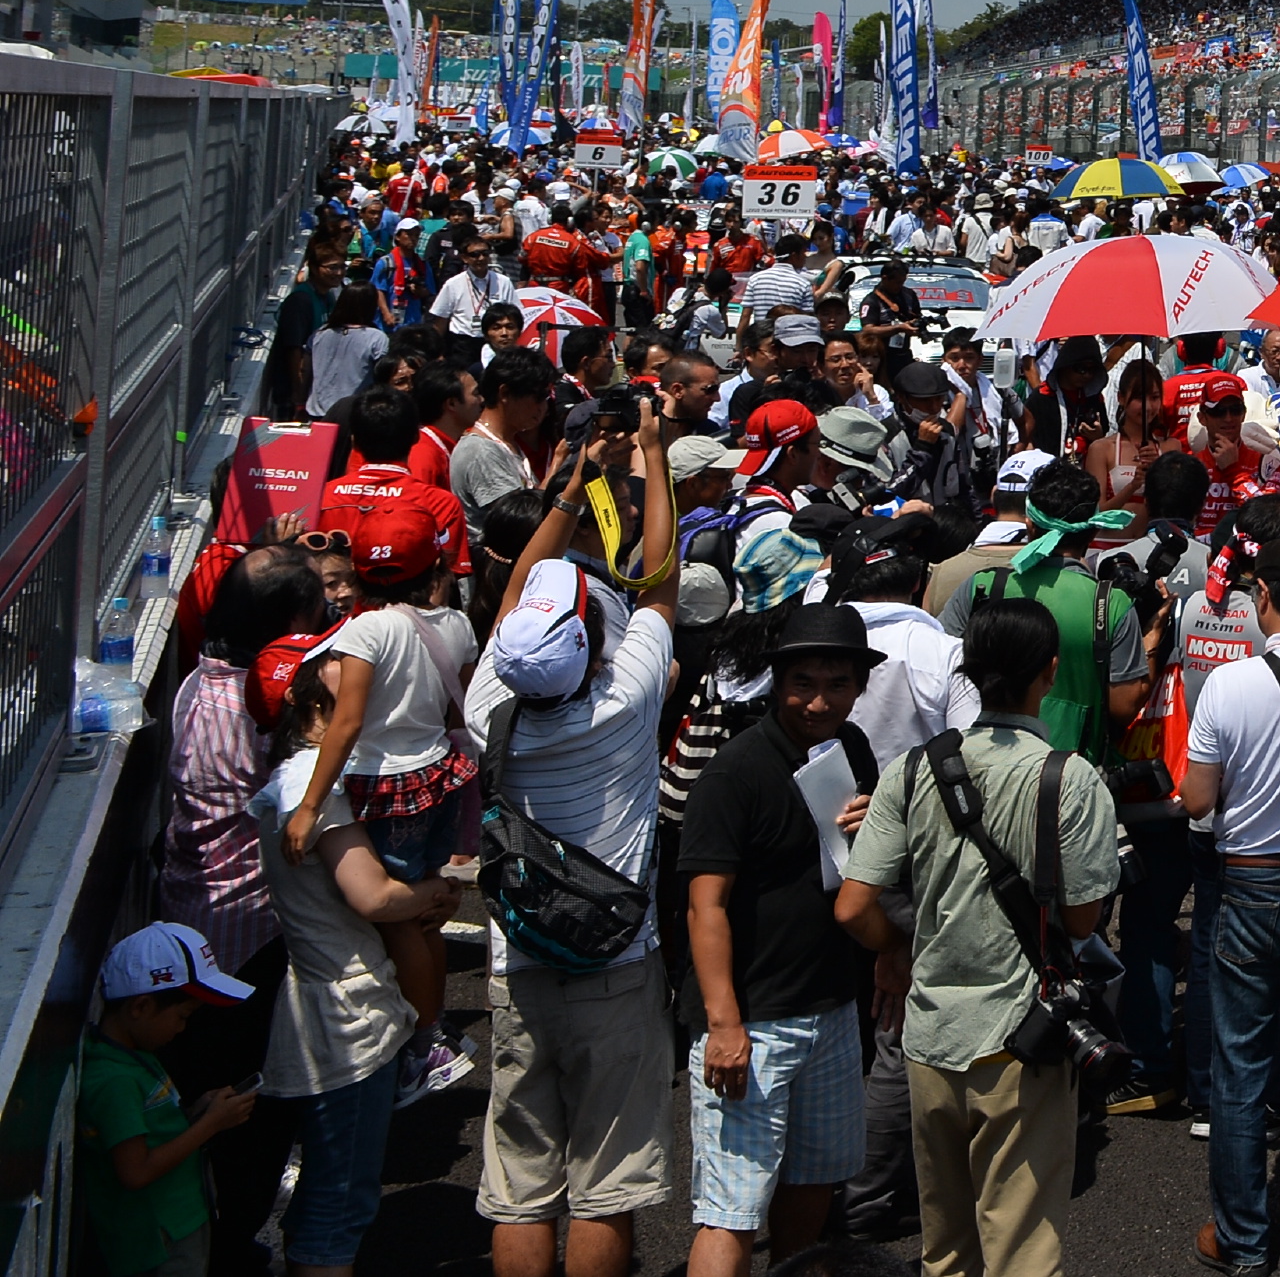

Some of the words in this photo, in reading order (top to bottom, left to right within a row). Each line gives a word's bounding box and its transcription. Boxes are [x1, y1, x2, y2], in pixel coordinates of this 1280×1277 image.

[591, 146, 605, 160] 6
[1028, 150, 1050, 161] 100
[757, 182, 801, 206] 36
[986, 255, 1078, 329] AUTECH
[1172, 249, 1214, 325] AUTECH
[861, 305, 869, 317] 9
[1179, 383, 1206, 391] NISSA
[1011, 460, 1026, 469] 23
[249, 467, 309, 480] NISSAN
[334, 484, 403, 497] NISSAN
[369, 545, 392, 560] 23
[1096, 598, 1105, 630] Canon
[1198, 604, 1249, 619] NISSAN
[1188, 637, 1248, 659] MOTUL
